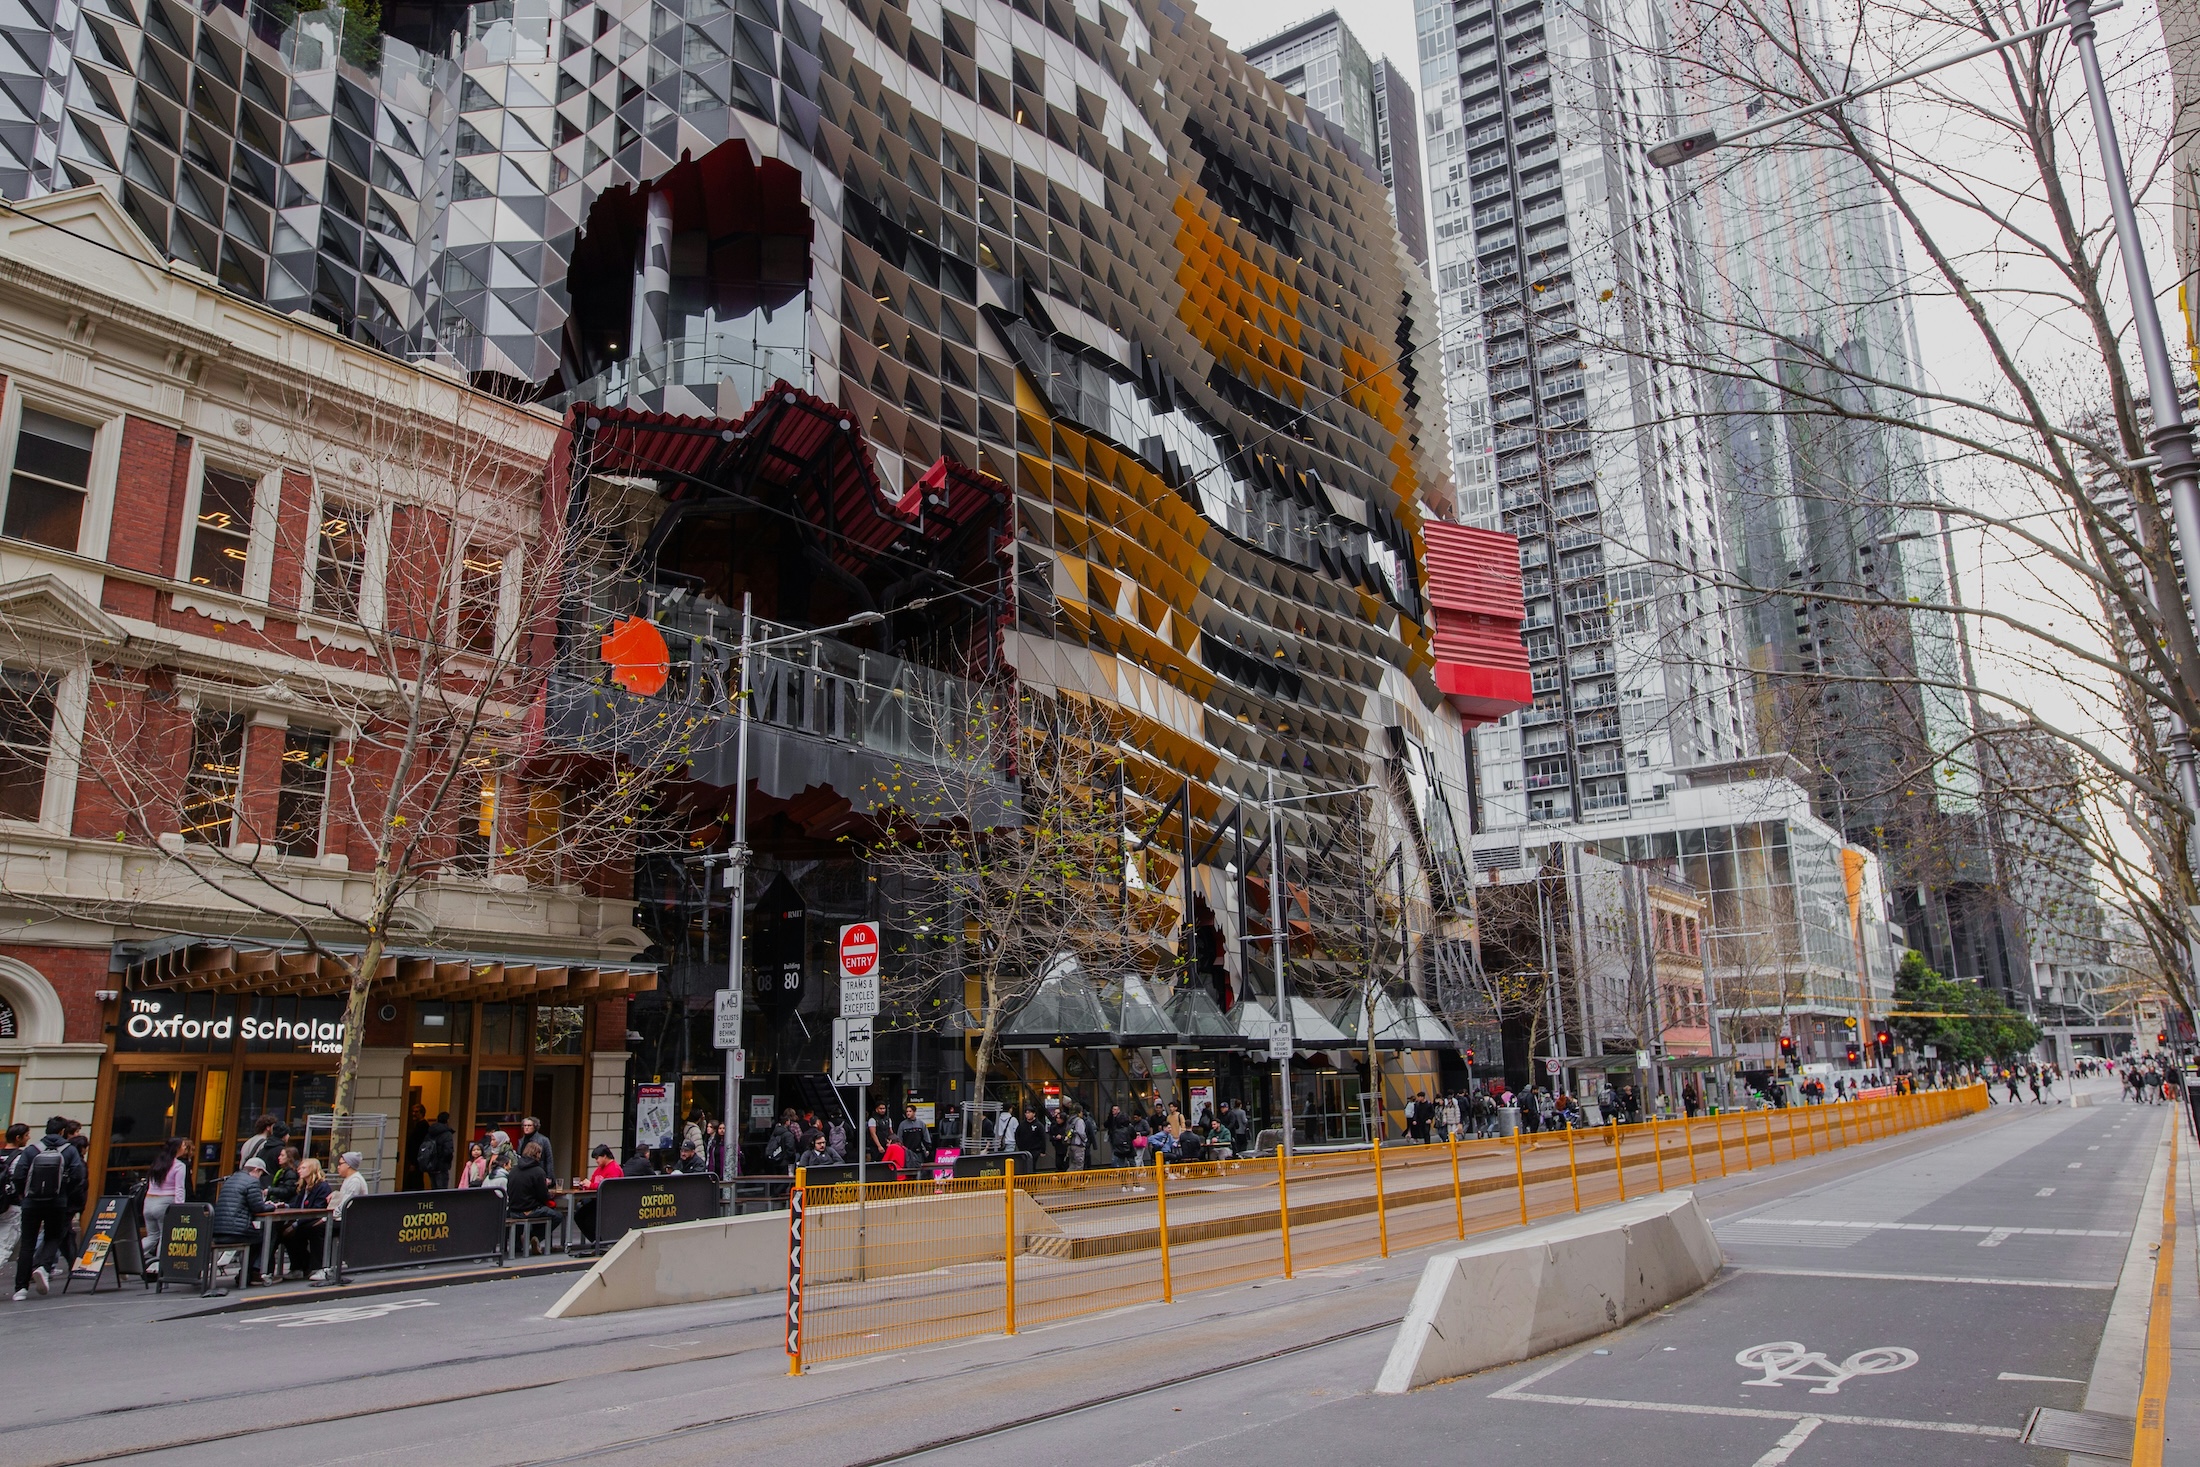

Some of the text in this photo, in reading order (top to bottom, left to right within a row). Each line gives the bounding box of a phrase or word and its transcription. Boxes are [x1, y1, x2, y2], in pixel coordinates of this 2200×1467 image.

[787, 910, 803, 918] RMIT
[853, 932, 866, 943] NO
[783, 962, 800, 970] Building
[845, 956, 873, 968] ENTRY
[784, 972, 799, 989] 80
[846, 979, 873, 990] TRAMS &
[844, 991, 875, 1001] BICYCLES
[131, 1000, 161, 1013] The
[844, 1002, 875, 1013] EXCEPTED
[127, 1014, 346, 1040] Oxford Scholar
[311, 1041, 343, 1053] Hote
[849, 1050, 870, 1062] ONLY
[417, 1201, 434, 1210] THE
[641, 1194, 675, 1207] OXFORD
[638, 1206, 677, 1219] SCHOLAR
[180, 1215, 190, 1223] THE
[402, 1211, 448, 1228] OXFORD
[171, 1227, 198, 1241] OXFORD
[398, 1226, 450, 1242] SCHOLAR
[167, 1242, 198, 1257] SCHOLAR
[409, 1243, 437, 1253] HOTEL
[173, 1261, 189, 1270] HOTEL
